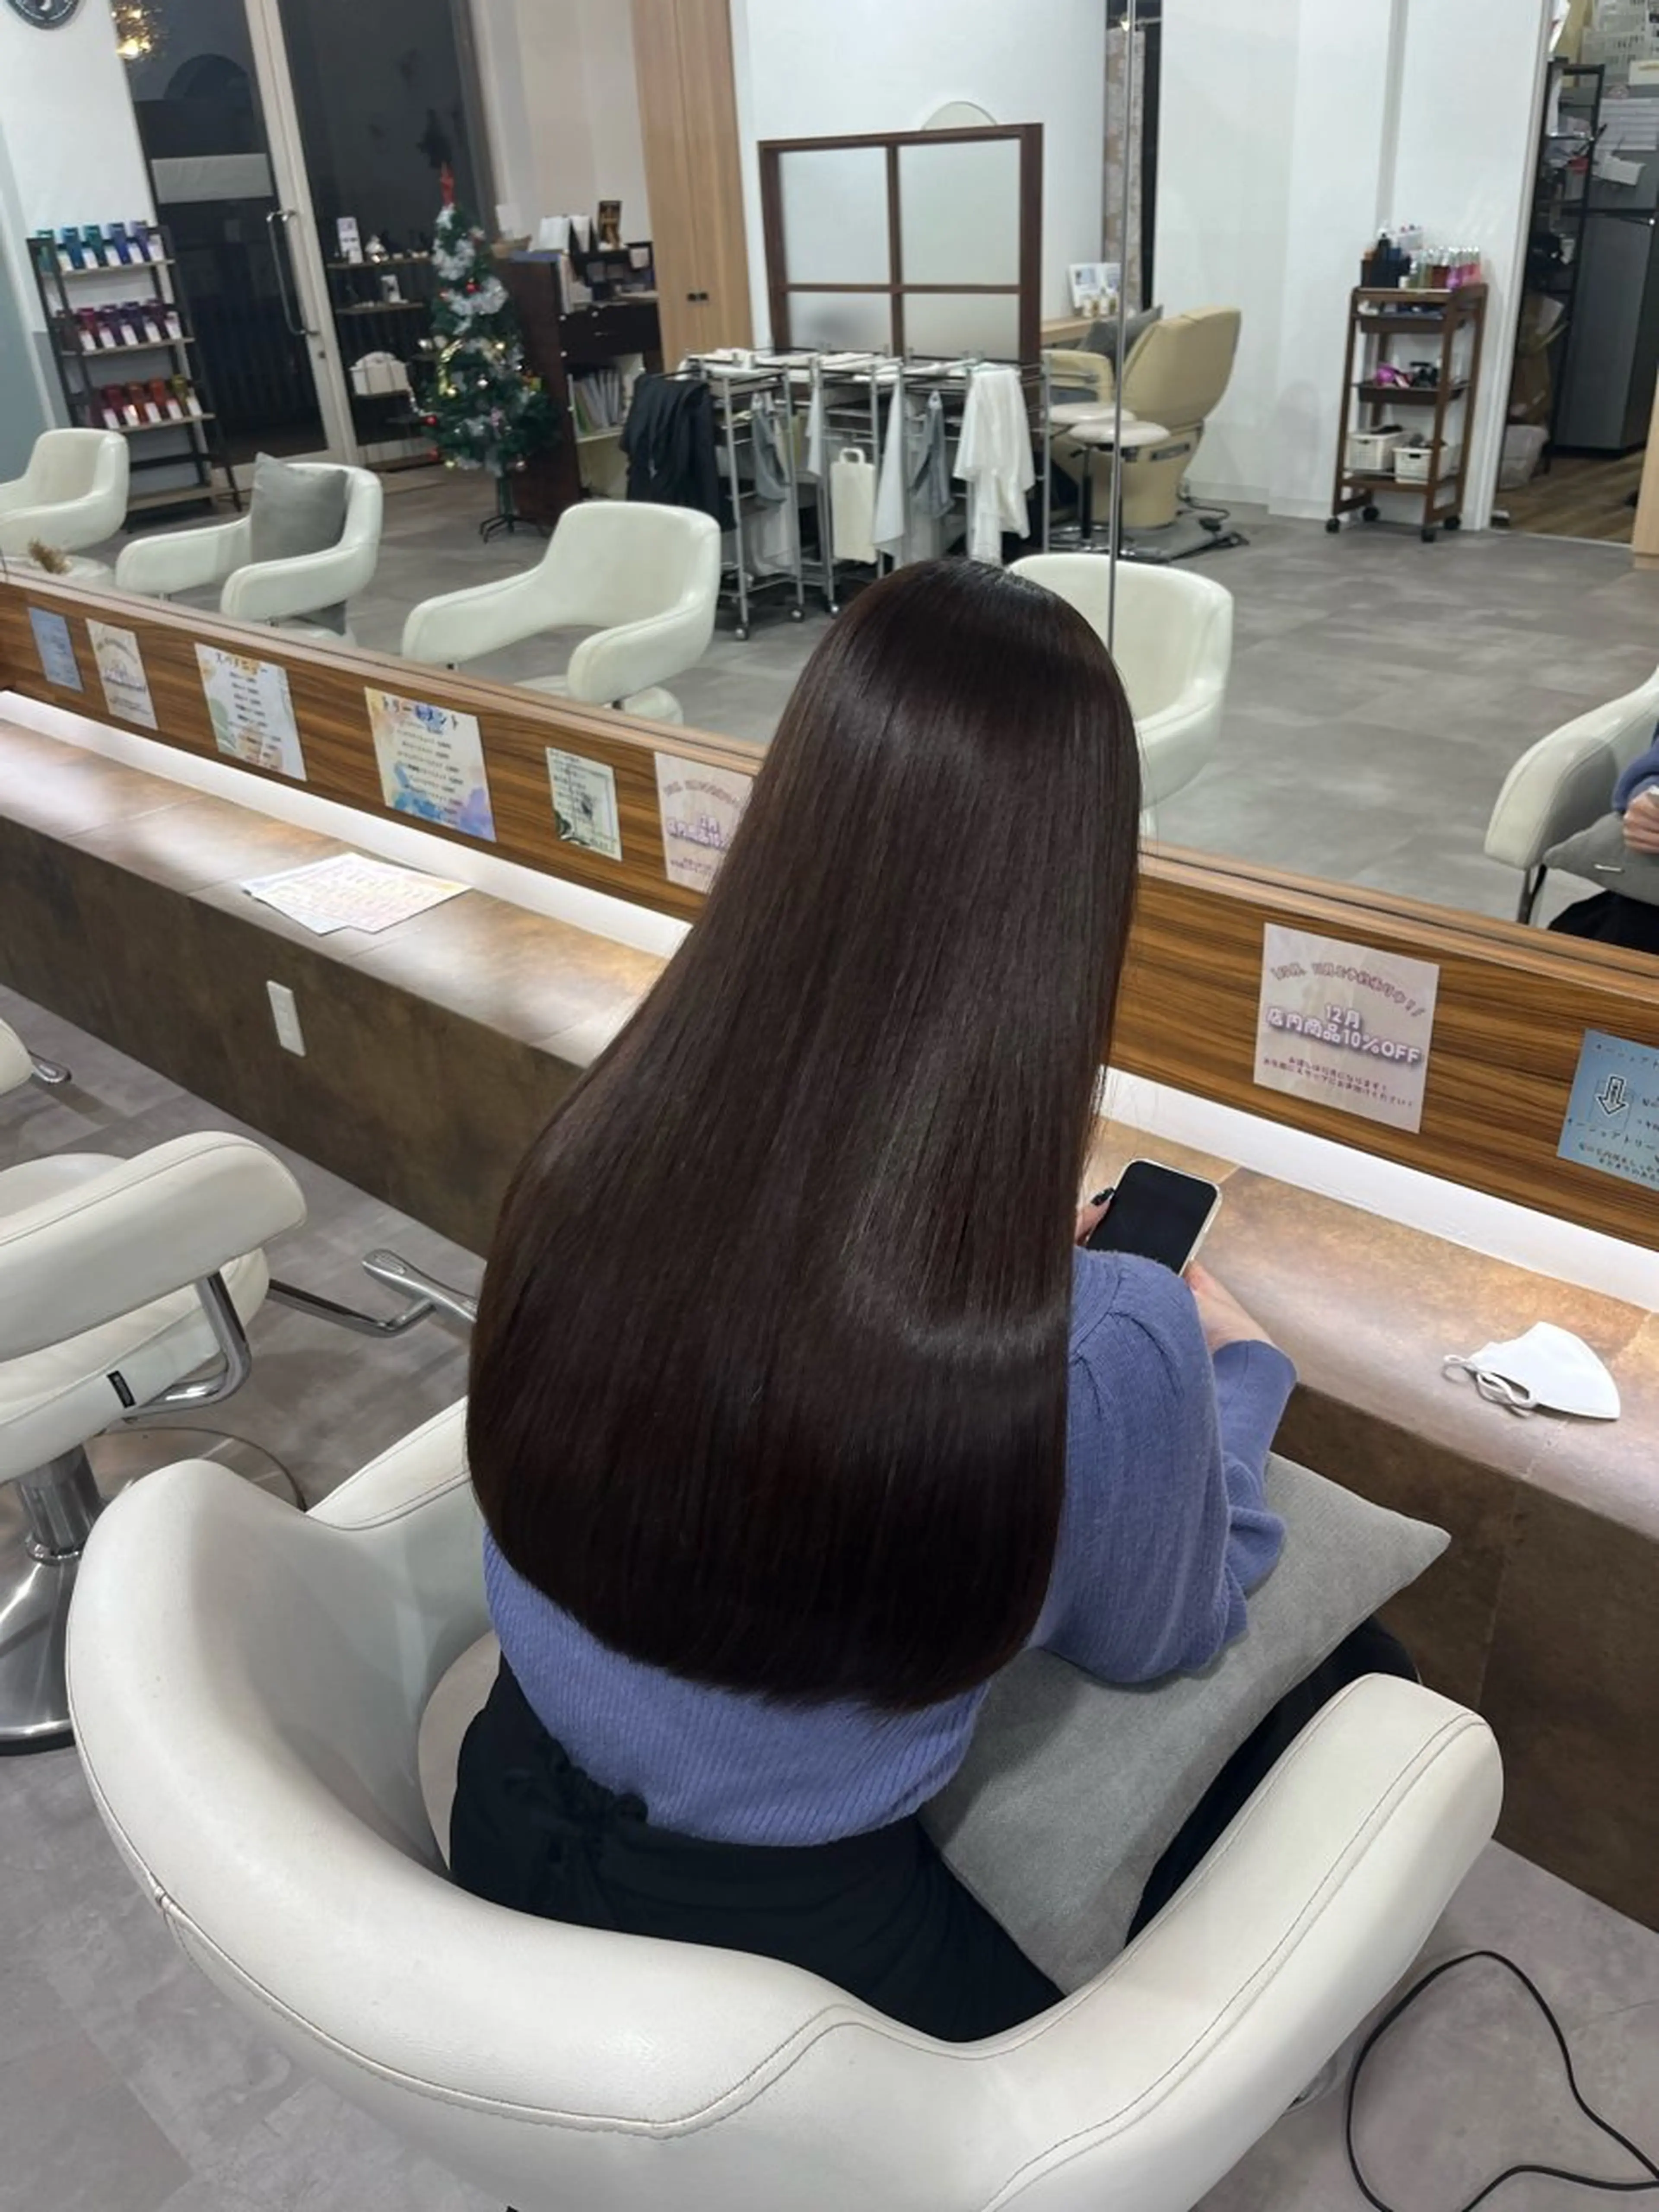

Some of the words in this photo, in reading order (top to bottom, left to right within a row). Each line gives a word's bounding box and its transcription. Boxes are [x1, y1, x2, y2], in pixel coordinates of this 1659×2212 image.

[1267, 1007, 1421, 1063] 店内商品10%OFF
[1325, 1005, 1361, 1030] 12月
